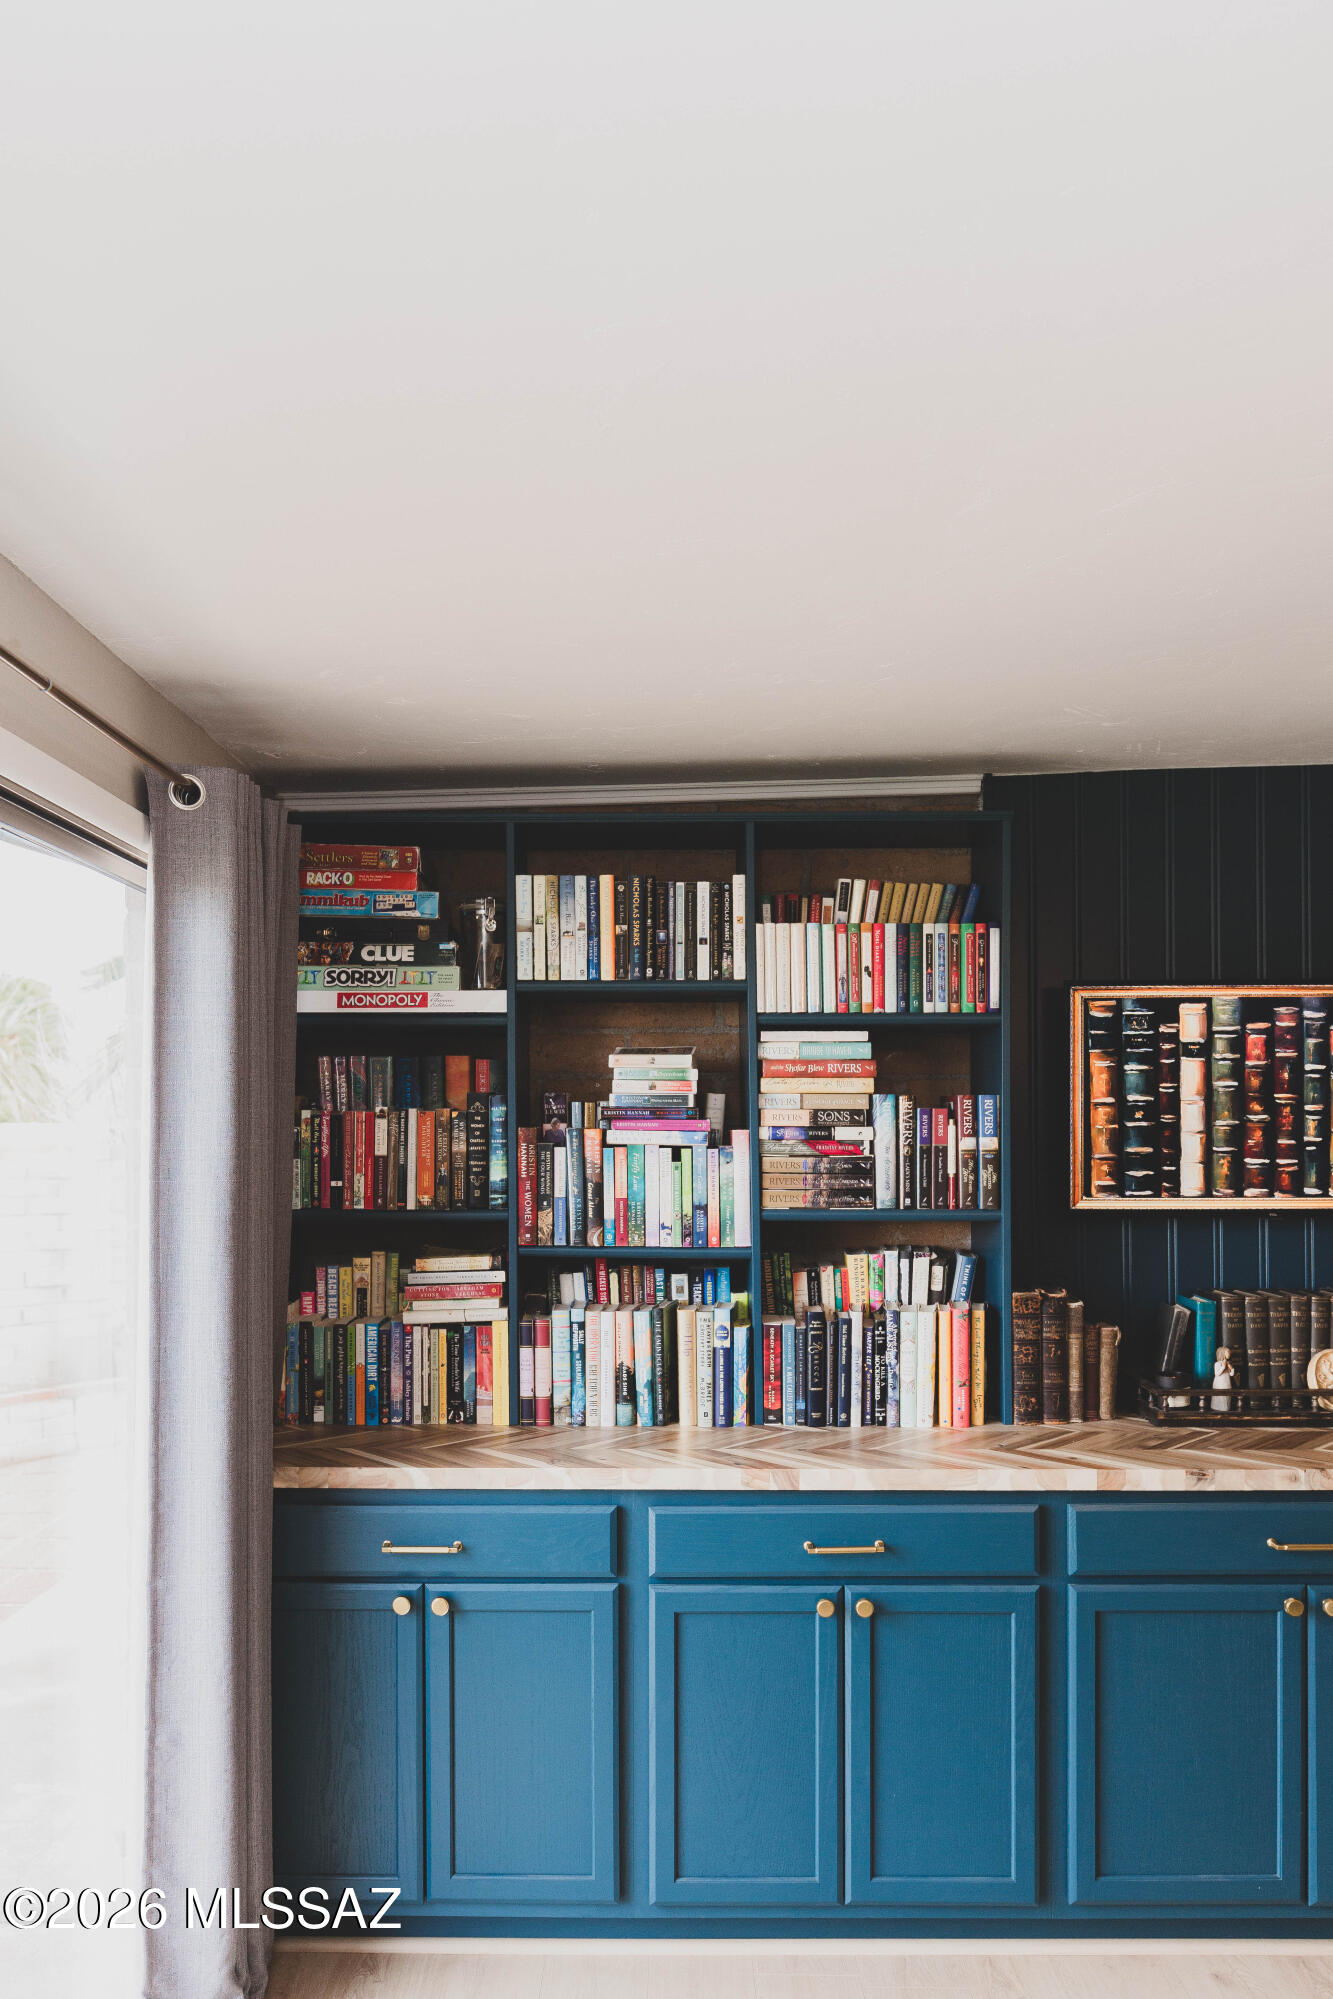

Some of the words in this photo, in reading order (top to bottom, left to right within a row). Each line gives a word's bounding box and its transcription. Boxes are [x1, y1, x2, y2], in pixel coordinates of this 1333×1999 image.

[305, 852, 353, 864] Settlers
[361, 945, 415, 962] CLUE
[324, 969, 397, 987] SORRY!
[342, 994, 423, 1007] MONOPOLY
[762, 1047, 794, 1055] RIVERS
[785, 1064, 806, 1072] Shofar
[808, 1064, 824, 1072] Blew
[828, 1064, 861, 1072] RIVERS
[764, 1098, 797, 1106] RIVERS
[818, 1111, 850, 1122] SONS
[903, 1100, 912, 1145] RIVERS
[963, 1099, 972, 1134] RIVERS
[984, 1099, 993, 1134] RIVERS
[524, 1192, 532, 1227] WOMEN
[327, 1268, 337, 1295] BEACH
[599, 1271, 607, 1291] WICKED
[961, 1264, 971, 1285] THINK
[960, 1286, 966, 1296] OF
[328, 1297, 337, 1319] READ
[591, 1314, 600, 1326] THE
[367, 1326, 377, 1363] AMERICAN
[590, 1329, 600, 1362] OPERATOR
[881, 1355, 885, 1364] TO
[367, 1365, 377, 1381] DIRT
[590, 1364, 600, 1398] GRETCHEN
[590, 1401, 600, 1416] BERG
